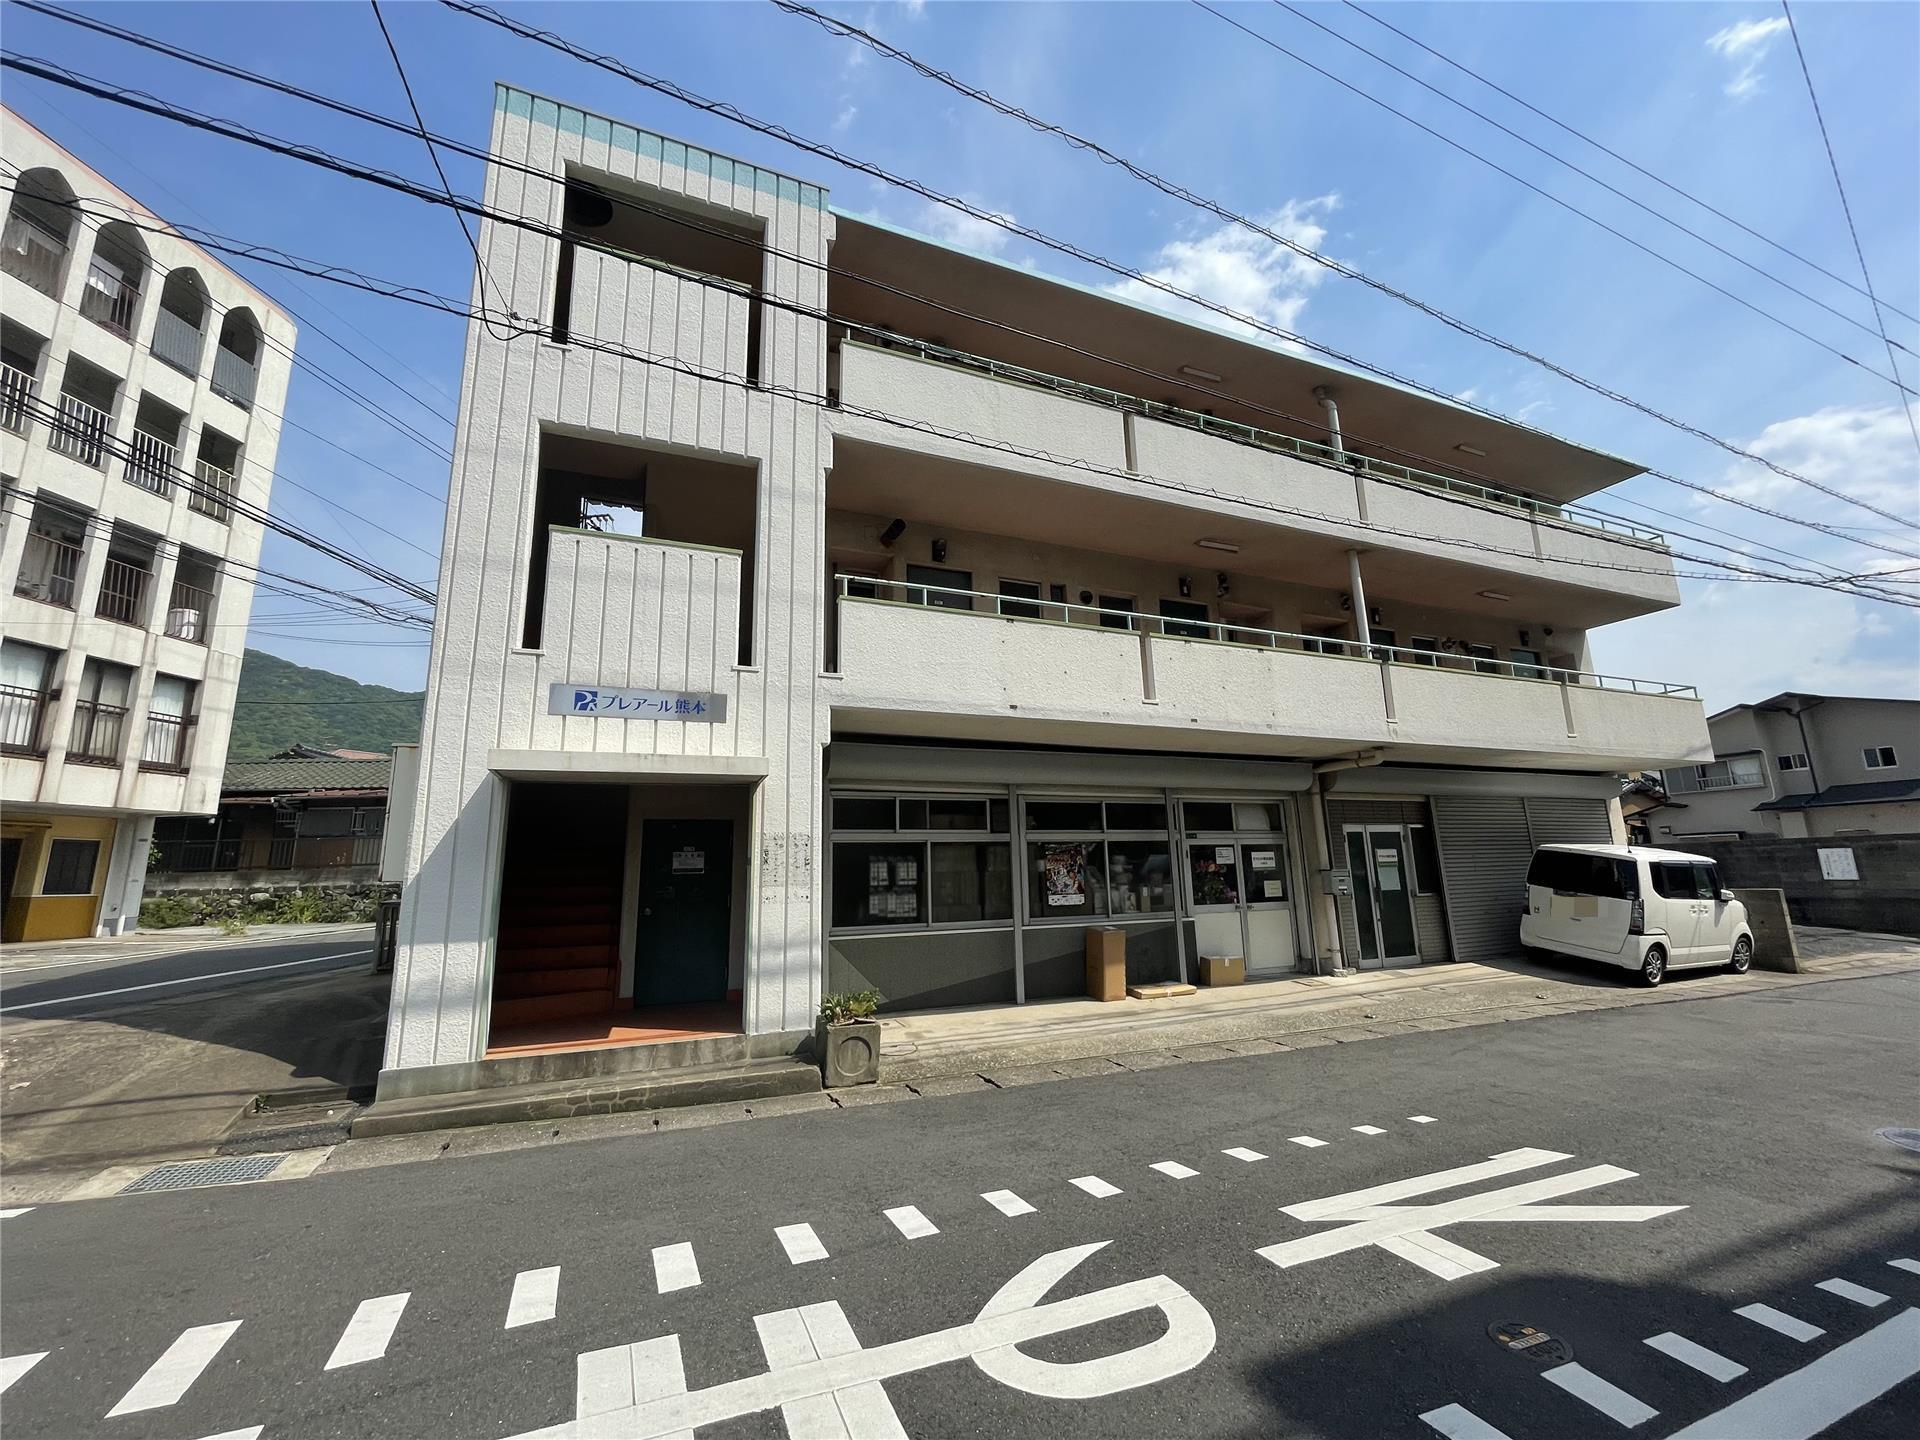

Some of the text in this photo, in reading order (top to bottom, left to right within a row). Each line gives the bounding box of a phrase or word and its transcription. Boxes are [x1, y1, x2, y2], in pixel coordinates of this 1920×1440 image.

[602, 696, 706, 714] プレアール熊本
